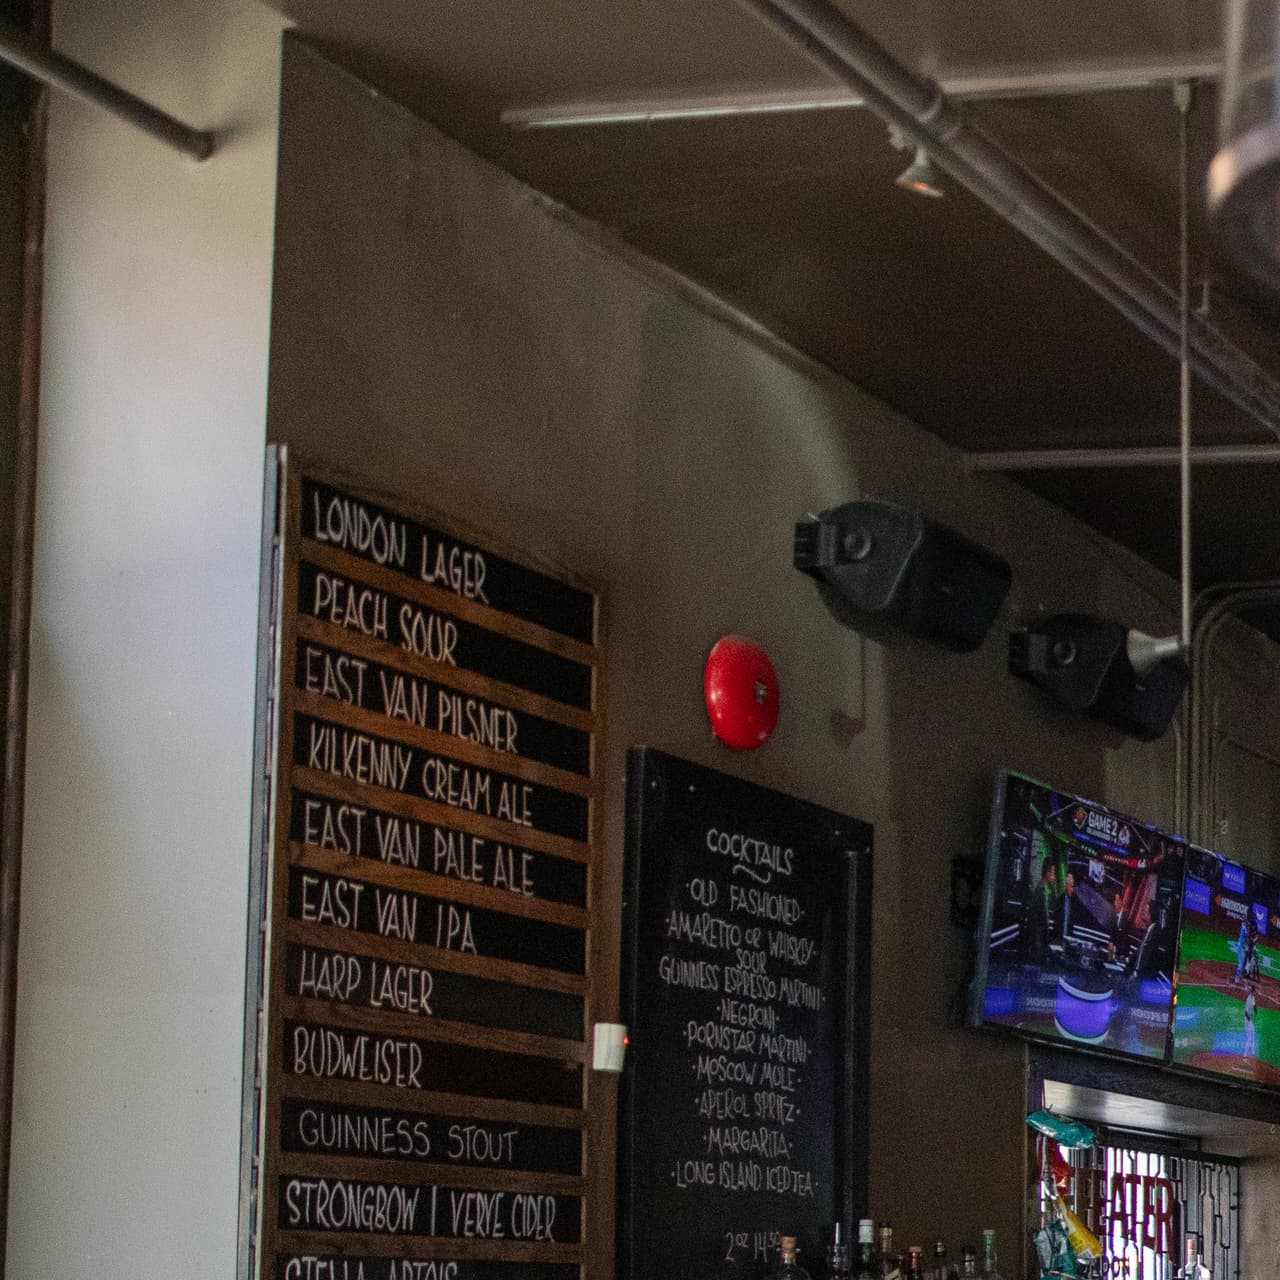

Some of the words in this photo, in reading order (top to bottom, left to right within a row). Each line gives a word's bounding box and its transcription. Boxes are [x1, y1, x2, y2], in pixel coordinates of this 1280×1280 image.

[314, 490, 405, 565] LONDON
[422, 534, 488, 602] LAGER
[314, 574, 387, 637] PEACH
[400, 605, 457, 667] SOUR
[306, 649, 367, 706] EAST
[380, 670, 426, 728] VAN
[439, 689, 517, 753] PILSNER
[309, 722, 412, 791] KILKENNY
[422, 758, 490, 815] CREAM
[498, 785, 533, 827] ALE
[306, 801, 368, 853] EAST
[376, 817, 420, 867] VAN
[434, 829, 484, 882] PALE
[493, 840, 534, 895] ALE
[707, 828, 794, 875] COCKTAILS
[302, 877, 364, 928] EAST
[375, 890, 417, 941] VAN
[437, 902, 476, 955] IPA
[690, 878, 718, 906] OLD
[730, 885, 800, 925] FASHIONED
[668, 910, 741, 950] AMARETTO
[301, 951, 360, 998] HARP
[371, 963, 432, 1015] LAGER
[660, 956, 718, 991] GUINNESS
[725, 966, 776, 1000] ESPRESSO
[779, 977, 820, 1010] MARTINI
[737, 949, 766, 974] SOUR
[721, 999, 775, 1030] NEGRONI
[293, 1027, 422, 1087] BUDWEISER
[687, 1021, 754, 1051] PORNSTAR
[759, 1034, 807, 1063] MARTINI
[697, 1056, 757, 1085] MOSCOW
[700, 1088, 748, 1120] APEROL
[754, 1092, 795, 1124] SPRITZ
[300, 1109, 430, 1157] GUINNESS
[447, 1126, 518, 1163] STOUT
[708, 1126, 790, 1159] MARGARITA
[676, 1161, 715, 1188] LONG
[719, 1162, 762, 1191] ISLAND
[766, 1166, 790, 1192] ICED
[790, 1171, 814, 1197] TEA
[286, 1178, 420, 1236] STRONGBOW
[512, 1195, 556, 1242] CIDER
